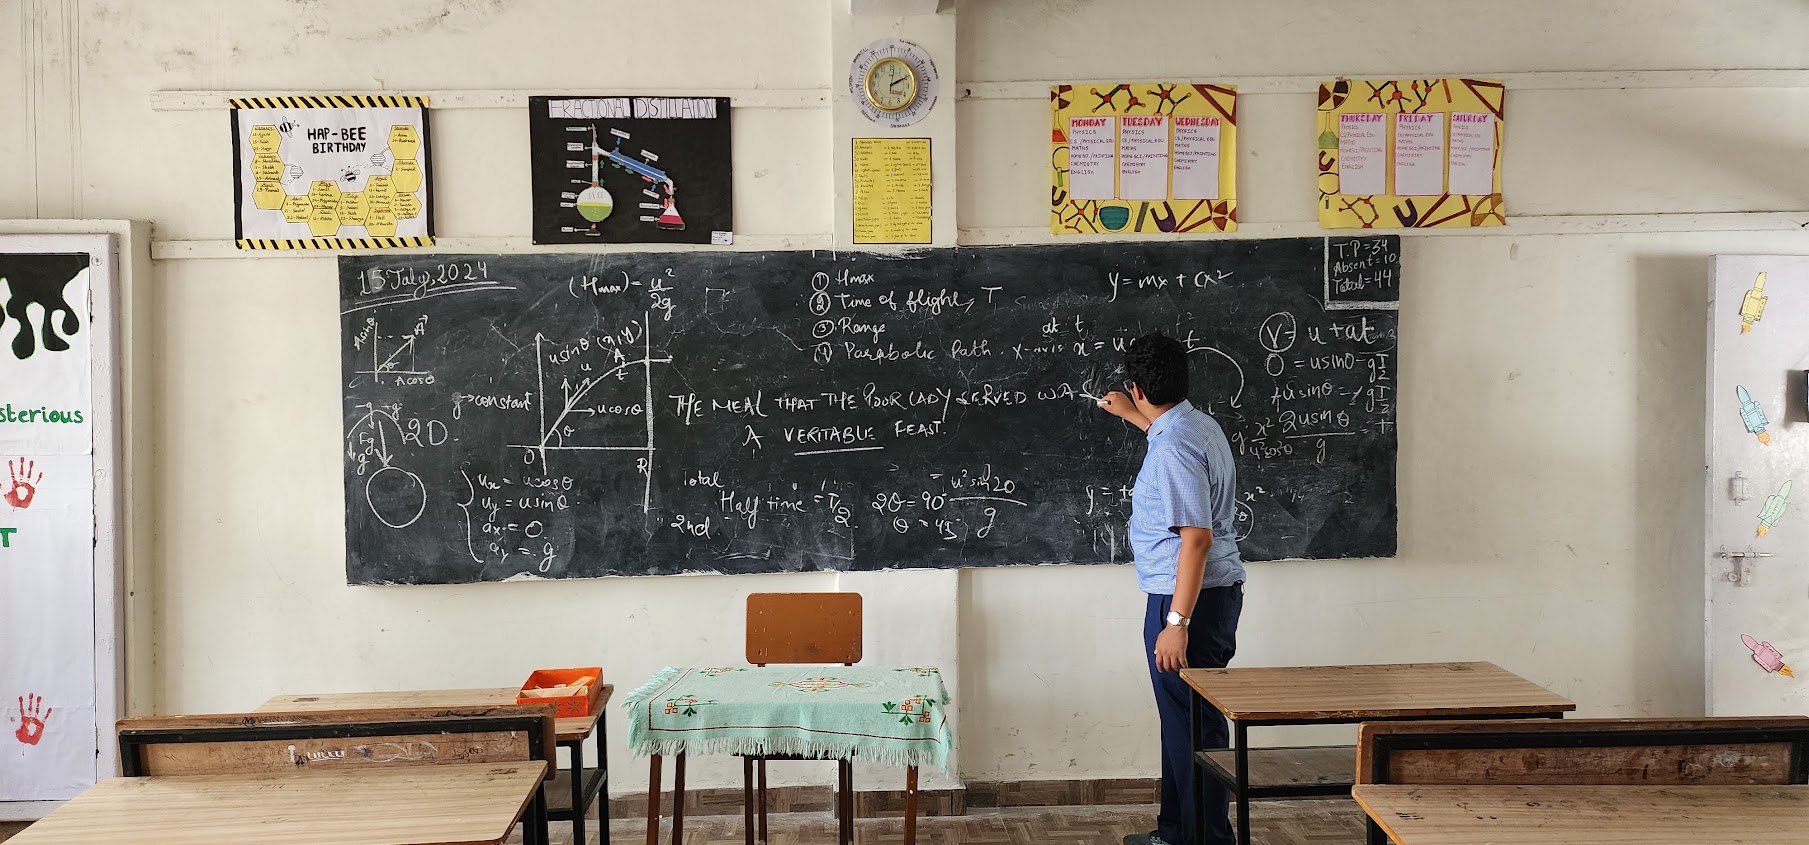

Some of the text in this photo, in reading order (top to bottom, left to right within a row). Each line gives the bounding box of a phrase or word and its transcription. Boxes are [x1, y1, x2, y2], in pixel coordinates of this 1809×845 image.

[1072, 118, 1107, 127] MONDAY
[1122, 117, 1163, 127] TUESDAY
[1175, 117, 1220, 126] WEDNESDAY
[312, 142, 366, 154] BIRTHDAY
[357, 267, 386, 296] 15
[834, 292, 872, 309] Time
[879, 294, 898, 310] of
[981, 286, 1002, 304] T
[838, 315, 886, 343] Range
[844, 342, 936, 365] Parabolic
[0, 404, 84, 423] sterious
[475, 392, 532, 412] constant
[669, 392, 704, 426] THE
[712, 389, 768, 418] MEAL
[775, 397, 821, 412] THAT
[821, 391, 858, 411] THE
[909, 387, 952, 424] LADY
[956, 384, 1027, 407] SERVED
[742, 424, 764, 450] A
[784, 426, 876, 444] VERITABLE
[671, 515, 711, 540] 2nd
